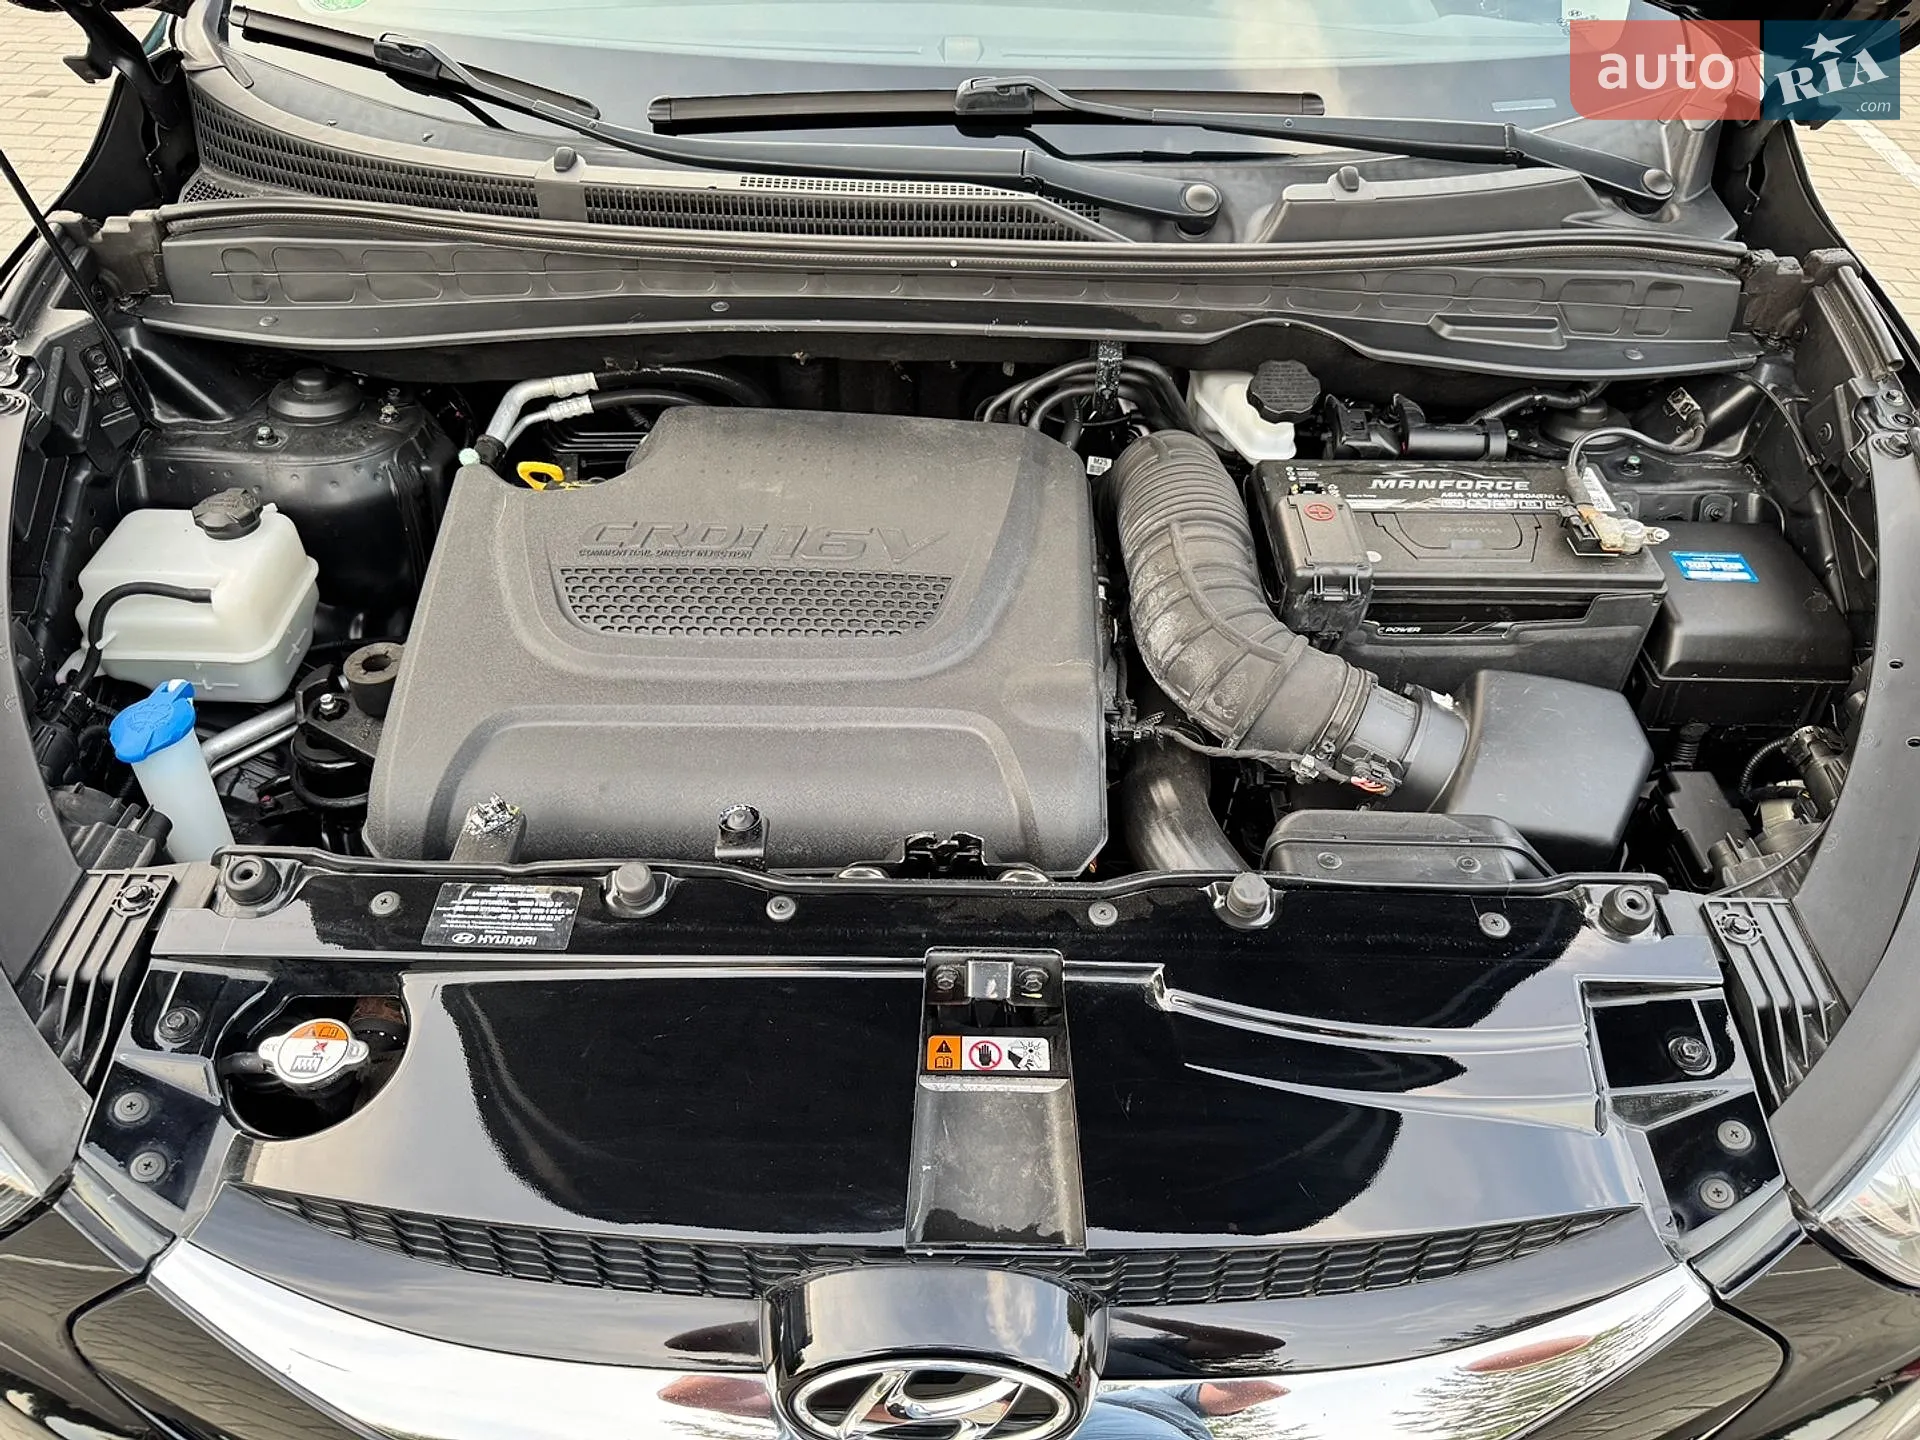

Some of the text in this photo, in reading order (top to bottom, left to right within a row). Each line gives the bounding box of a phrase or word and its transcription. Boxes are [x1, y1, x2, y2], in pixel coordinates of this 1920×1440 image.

[1368, 479, 1530, 491] MANFORCE
[1385, 626, 1422, 634] POWER
[477, 934, 538, 946] HYUNDAI
